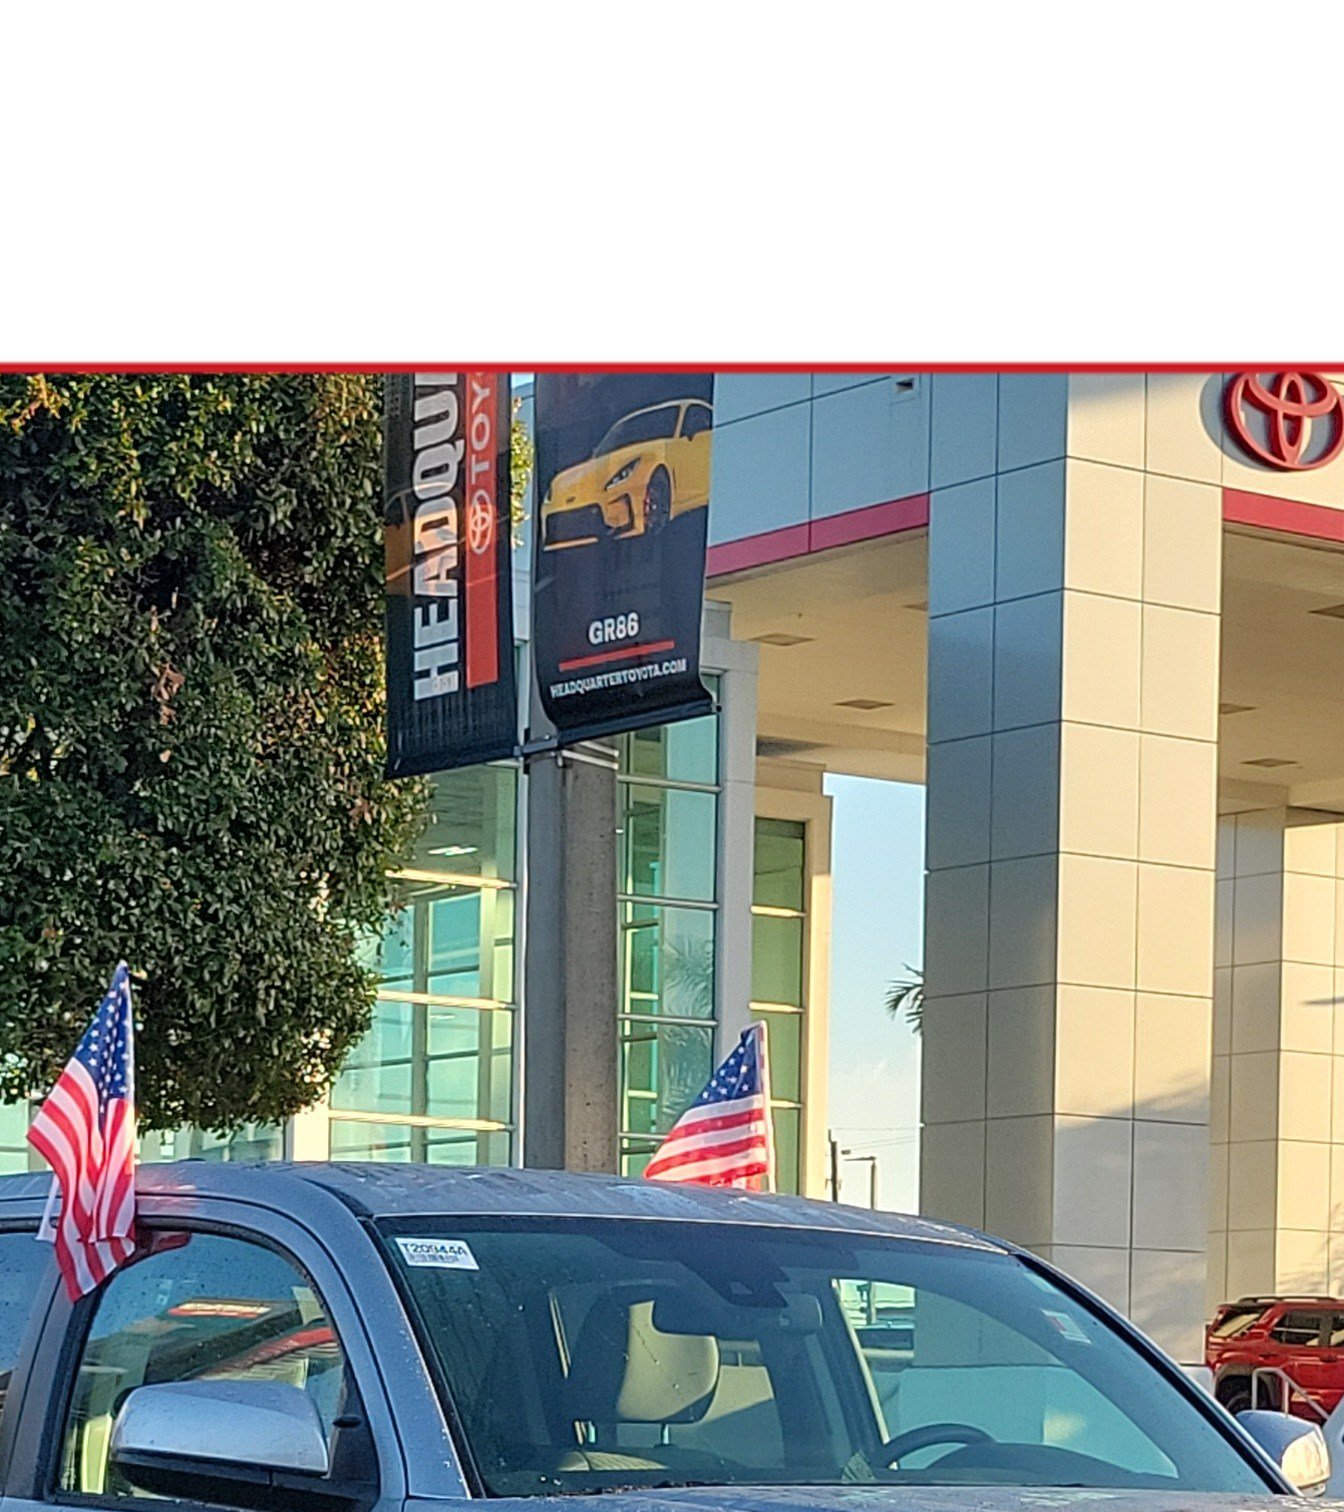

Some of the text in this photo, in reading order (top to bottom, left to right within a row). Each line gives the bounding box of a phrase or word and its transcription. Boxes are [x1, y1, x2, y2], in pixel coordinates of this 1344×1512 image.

[470, 373, 491, 486] TOY
[412, 373, 465, 700] HEADQU
[588, 611, 640, 645] GR86
[549, 658, 688, 699] HEADQUARTERTOYOTA.COM
